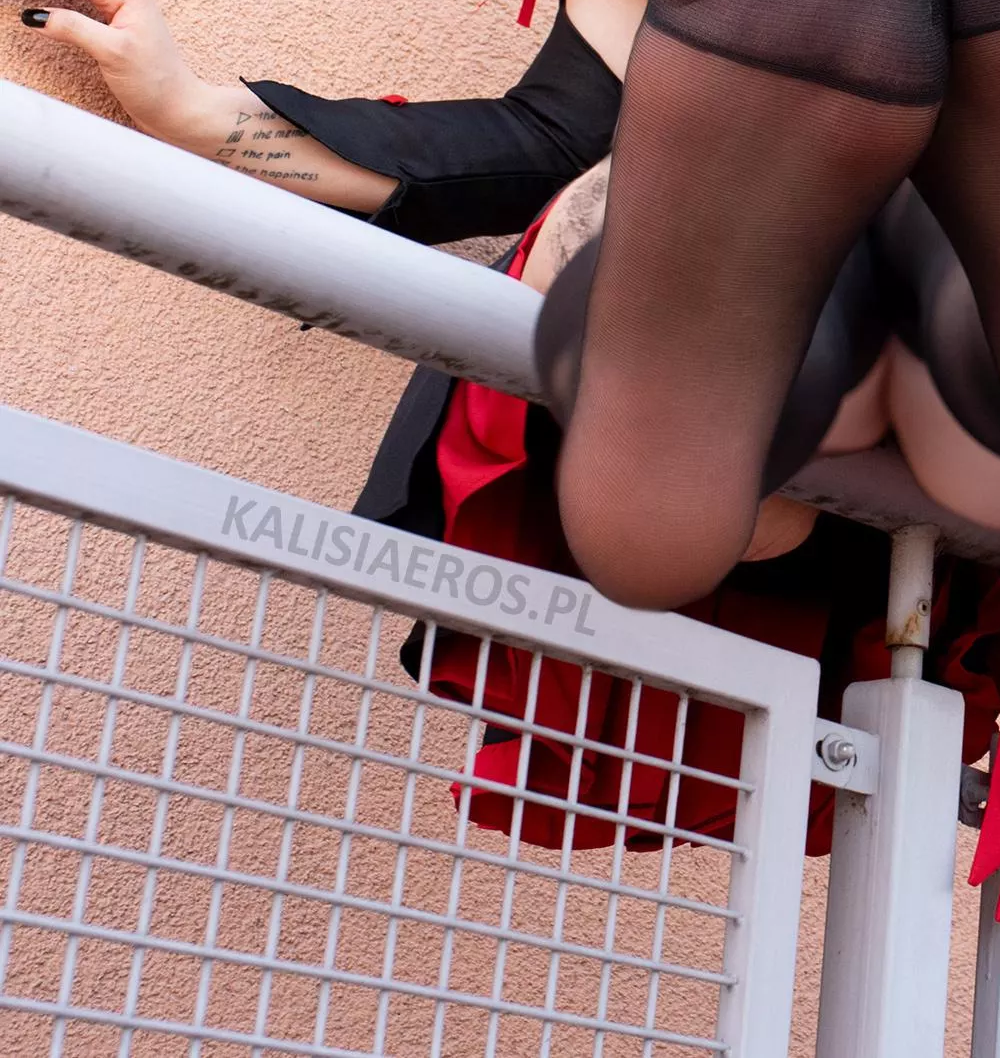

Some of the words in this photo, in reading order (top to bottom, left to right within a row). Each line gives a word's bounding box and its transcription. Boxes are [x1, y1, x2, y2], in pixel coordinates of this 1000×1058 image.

[252, 129, 272, 140] the
[241, 149, 263, 159] the
[265, 149, 291, 161] pain
[235, 164, 257, 174] the
